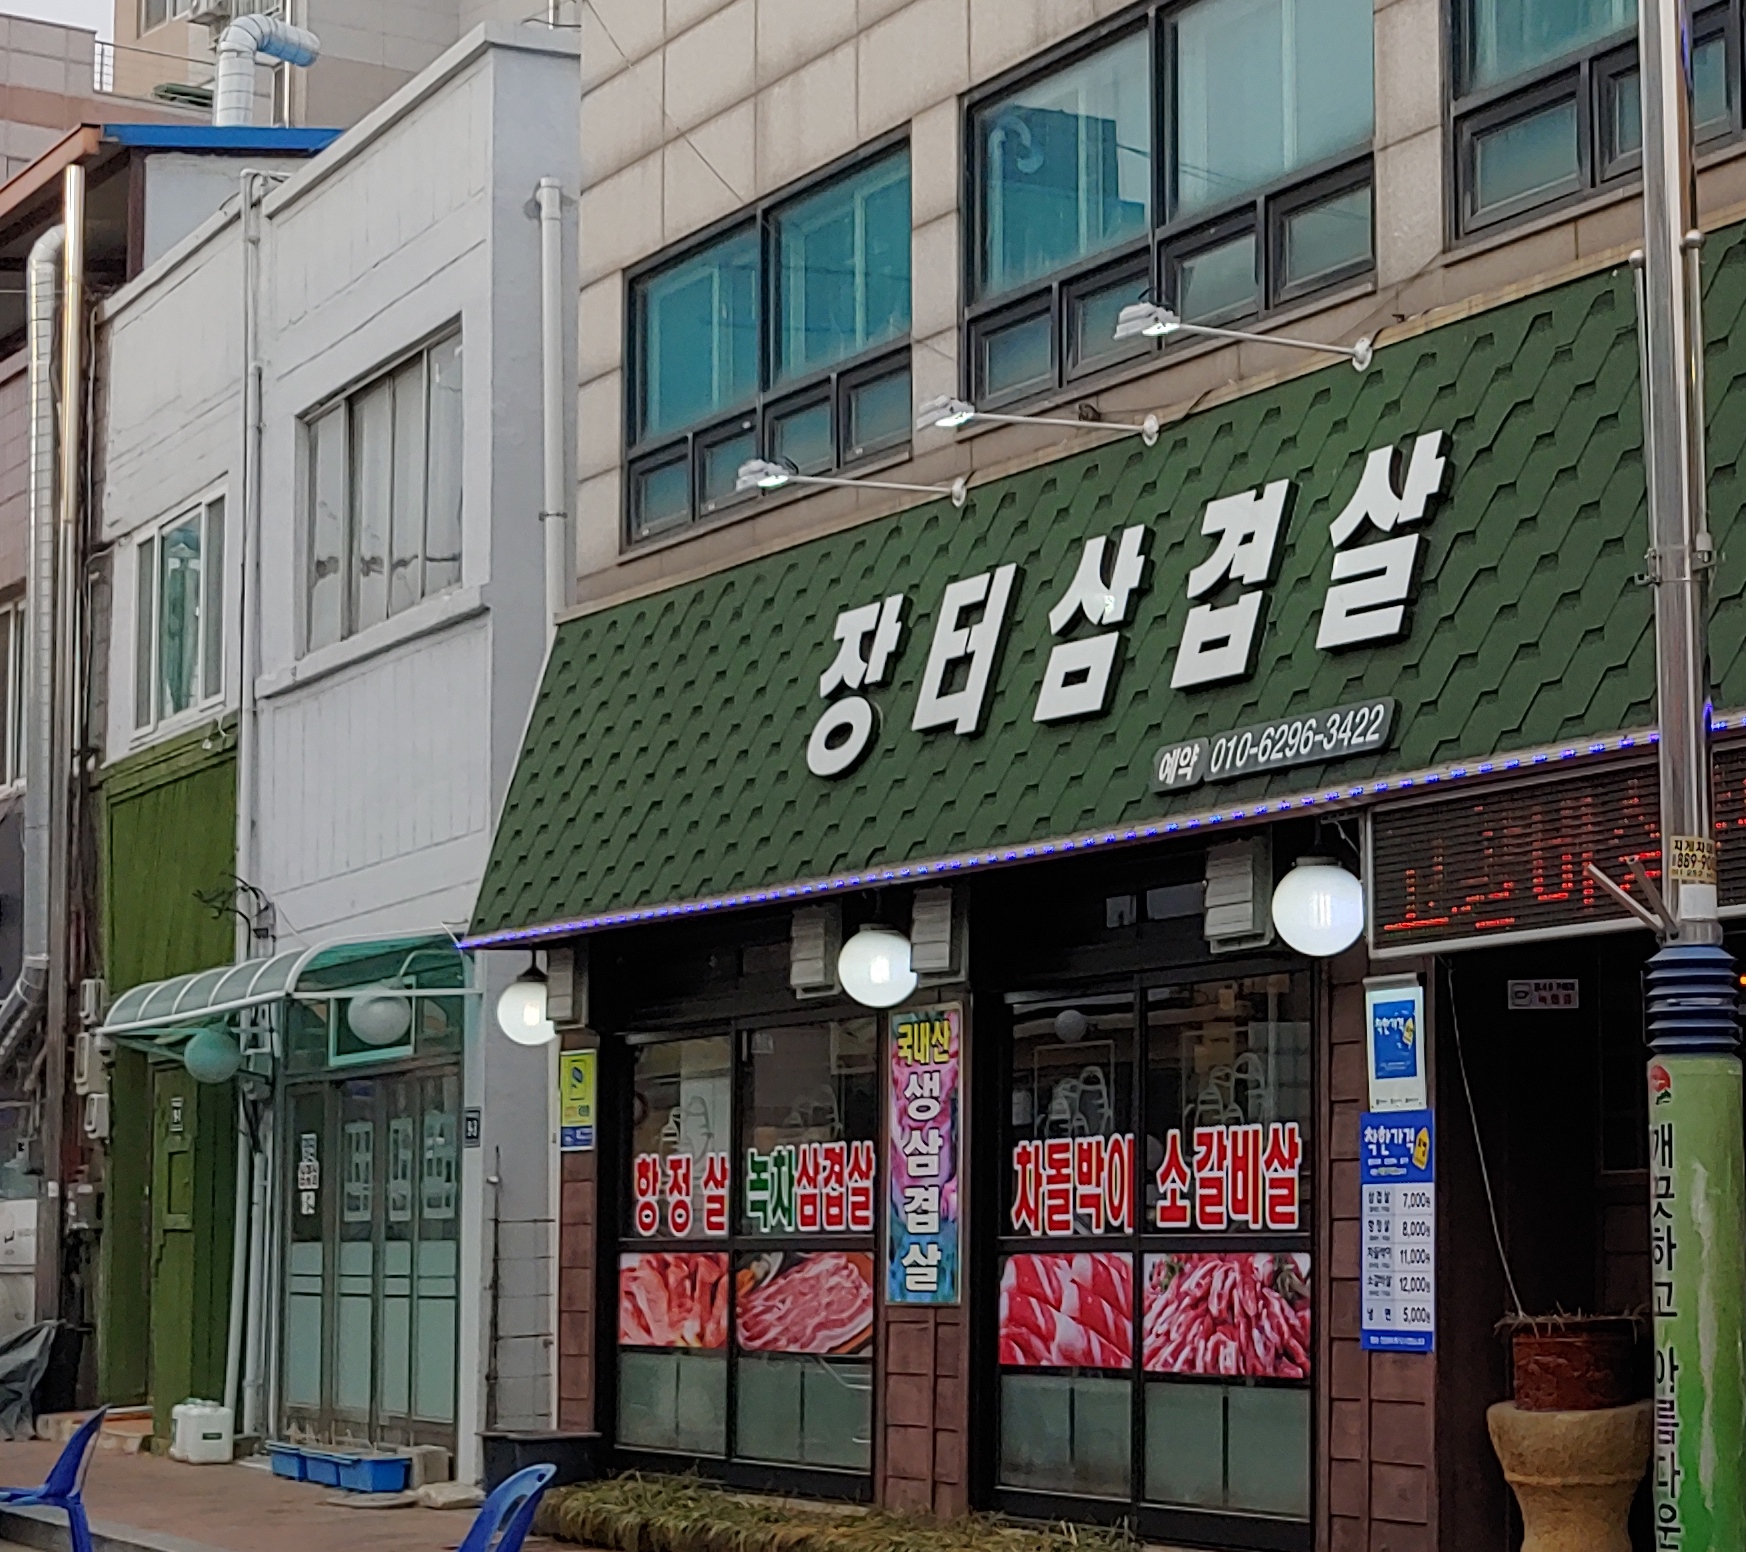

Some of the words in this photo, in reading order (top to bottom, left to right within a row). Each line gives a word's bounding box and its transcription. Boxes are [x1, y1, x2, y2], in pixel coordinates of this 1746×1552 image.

[1157, 741, 1200, 786] 예약
[1210, 702, 1387, 773] 010-6296-3422
[897, 1019, 951, 1066] 국내산
[1157, 1122, 1302, 1230] 소갈비살
[1364, 1125, 1415, 1156] 착한가격
[1011, 1133, 1134, 1236] 차돌박이
